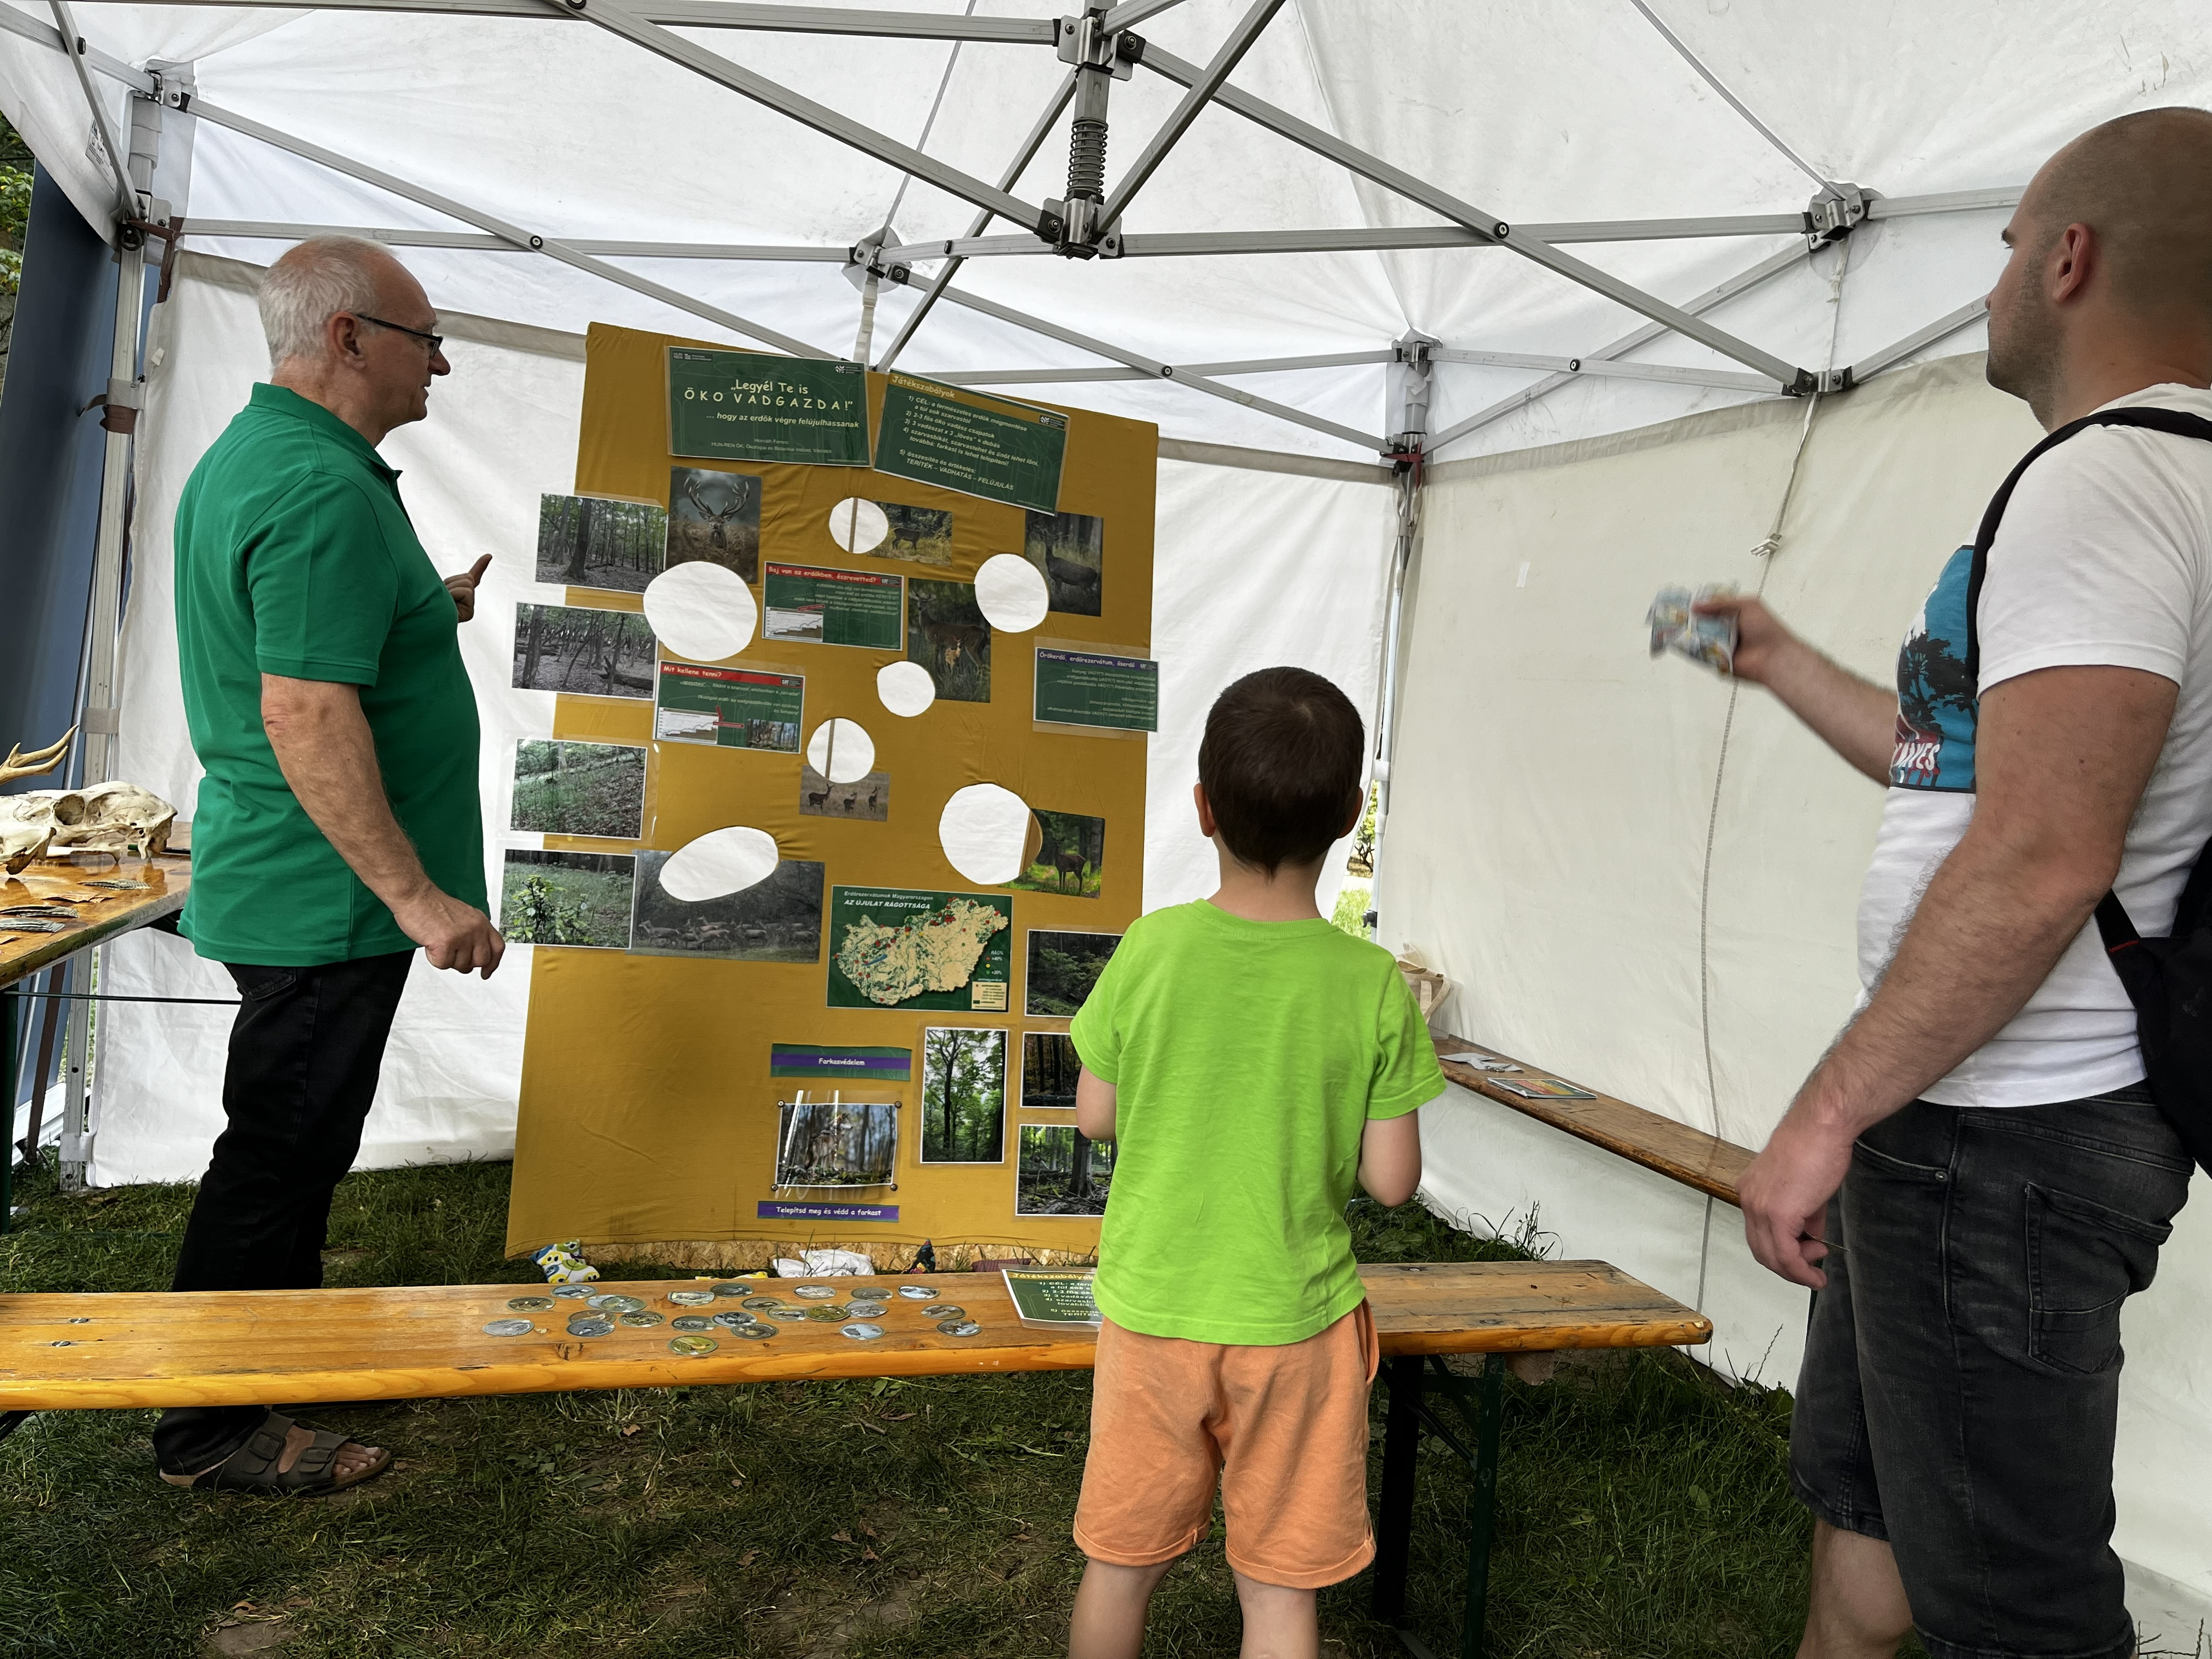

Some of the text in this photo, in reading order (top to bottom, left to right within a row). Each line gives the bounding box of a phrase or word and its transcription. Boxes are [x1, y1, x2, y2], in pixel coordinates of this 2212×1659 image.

[684, 386, 723, 402] ÖKO
[730, 378, 808, 394] „Legyél Te is
[891, 375, 955, 399] Játékszabályok
[716, 412, 737, 421] hogy
[775, 416, 796, 425] végre
[798, 417, 860, 430] felújulhassanak
[936, 403, 971, 417] természetes
[972, 413, 989, 421] erdők
[990, 417, 1027, 432] megmentése
[941, 411, 970, 424] szarvastól
[917, 421, 943, 433] vadászat
[982, 439, 1000, 448] dobás
[947, 421, 967, 431] vadász
[968, 427, 995, 439] csapatok
[936, 442, 957, 453] farkast
[964, 450, 979, 459] lehet
[1011, 454, 1025, 463] lehet
[906, 458, 933, 470] TERÍTÉK
[939, 465, 972, 479] VADHATÁS
[768, 566, 779, 574] Baj
[676, 667, 699, 675] kellene
[884, 900, 930, 909] RÁGOTTSÁGA
[819, 1058, 865, 1066] Farkasvédelem
